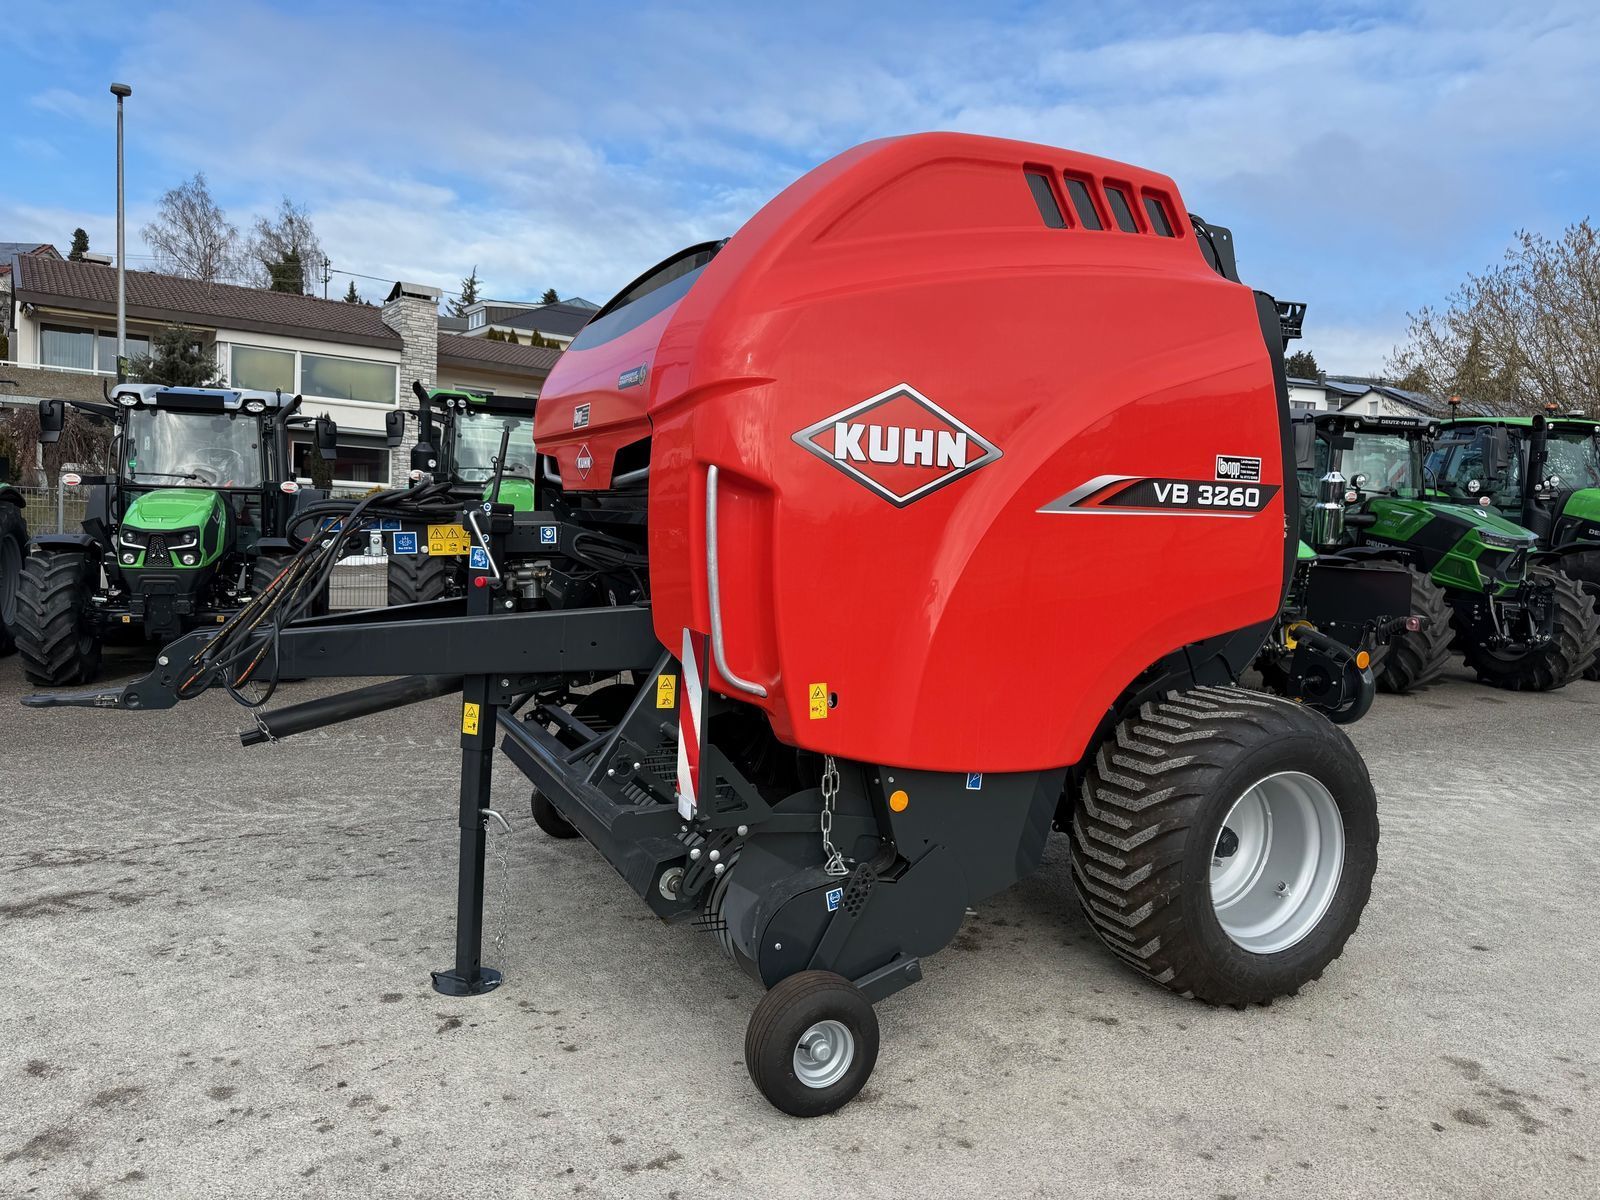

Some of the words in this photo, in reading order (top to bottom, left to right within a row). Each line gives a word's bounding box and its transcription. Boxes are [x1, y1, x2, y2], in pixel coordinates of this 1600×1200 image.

[834, 421, 967, 470] KUHN
[1153, 482, 1189, 504] VB
[1197, 485, 1260, 508] 3260
